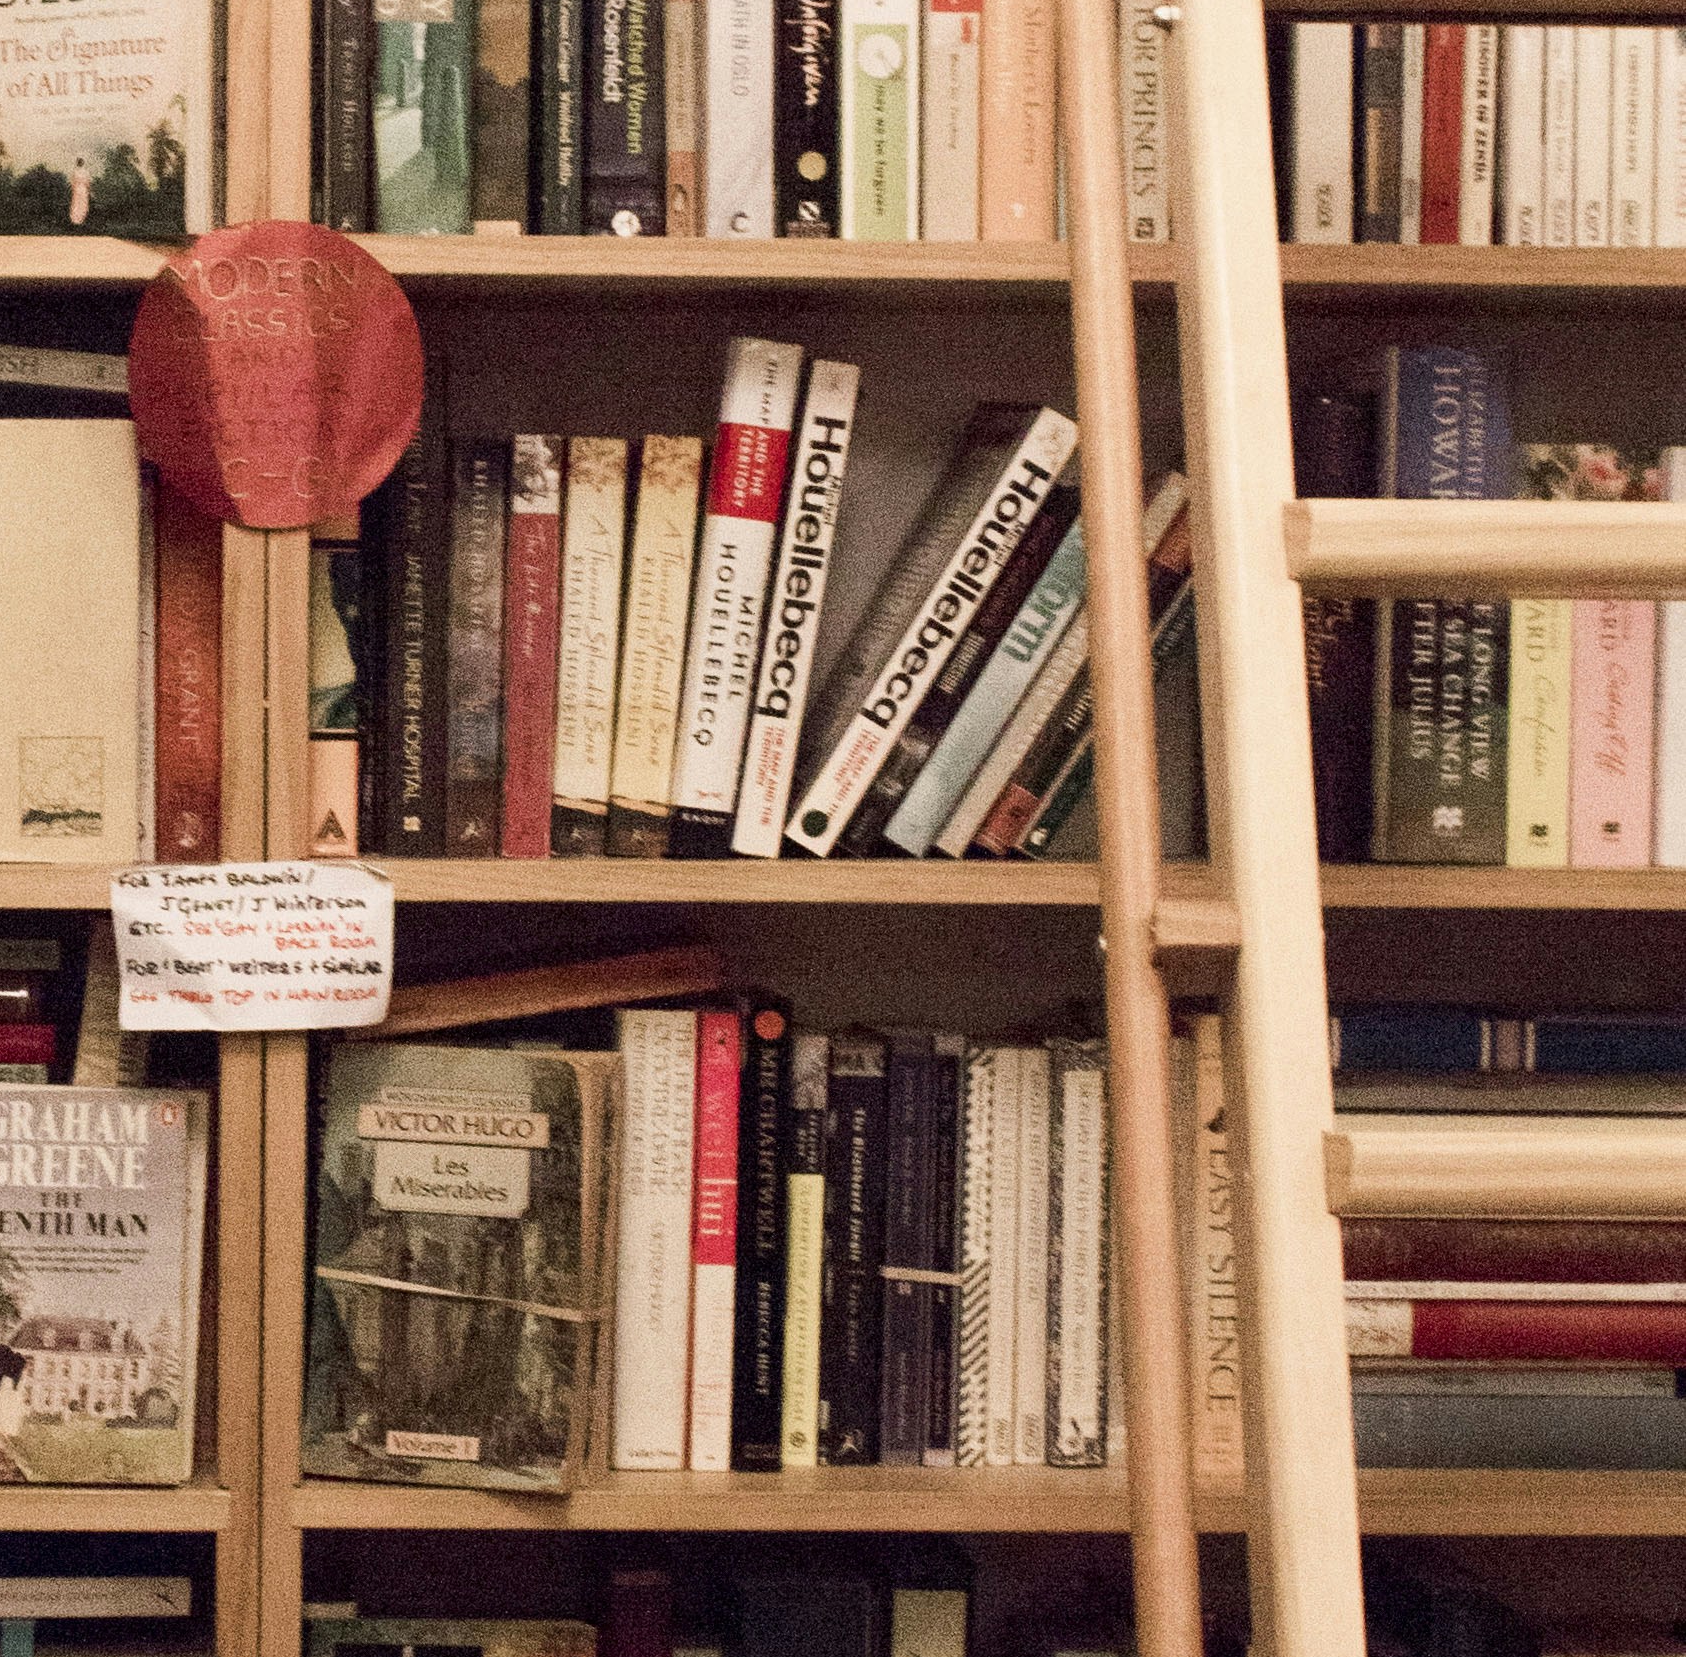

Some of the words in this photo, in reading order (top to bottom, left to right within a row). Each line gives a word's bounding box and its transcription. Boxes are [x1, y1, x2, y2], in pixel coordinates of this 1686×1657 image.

[731, 33, 751, 50] IN
[5, 72, 35, 99] of
[36, 70, 69, 98] All
[75, 70, 154, 100] Things
[731, 55, 751, 97] OSLO
[754, 414, 847, 719] Houellebecq
[862, 456, 1050, 730] Houellebecq
[1444, 675, 1463, 787] CHANGE
[1469, 710, 1492, 782] VIEW
[375, 1111, 455, 1136] VICTOR
[461, 1113, 535, 1138] HUGO
[1208, 1146, 1229, 1235] EASY
[84, 1210, 149, 1239] MAN
[756, 1280, 773, 1337] REBECCA
[1208, 1248, 1237, 1413] SILENCE
[755, 1340, 771, 1396] HUNT
